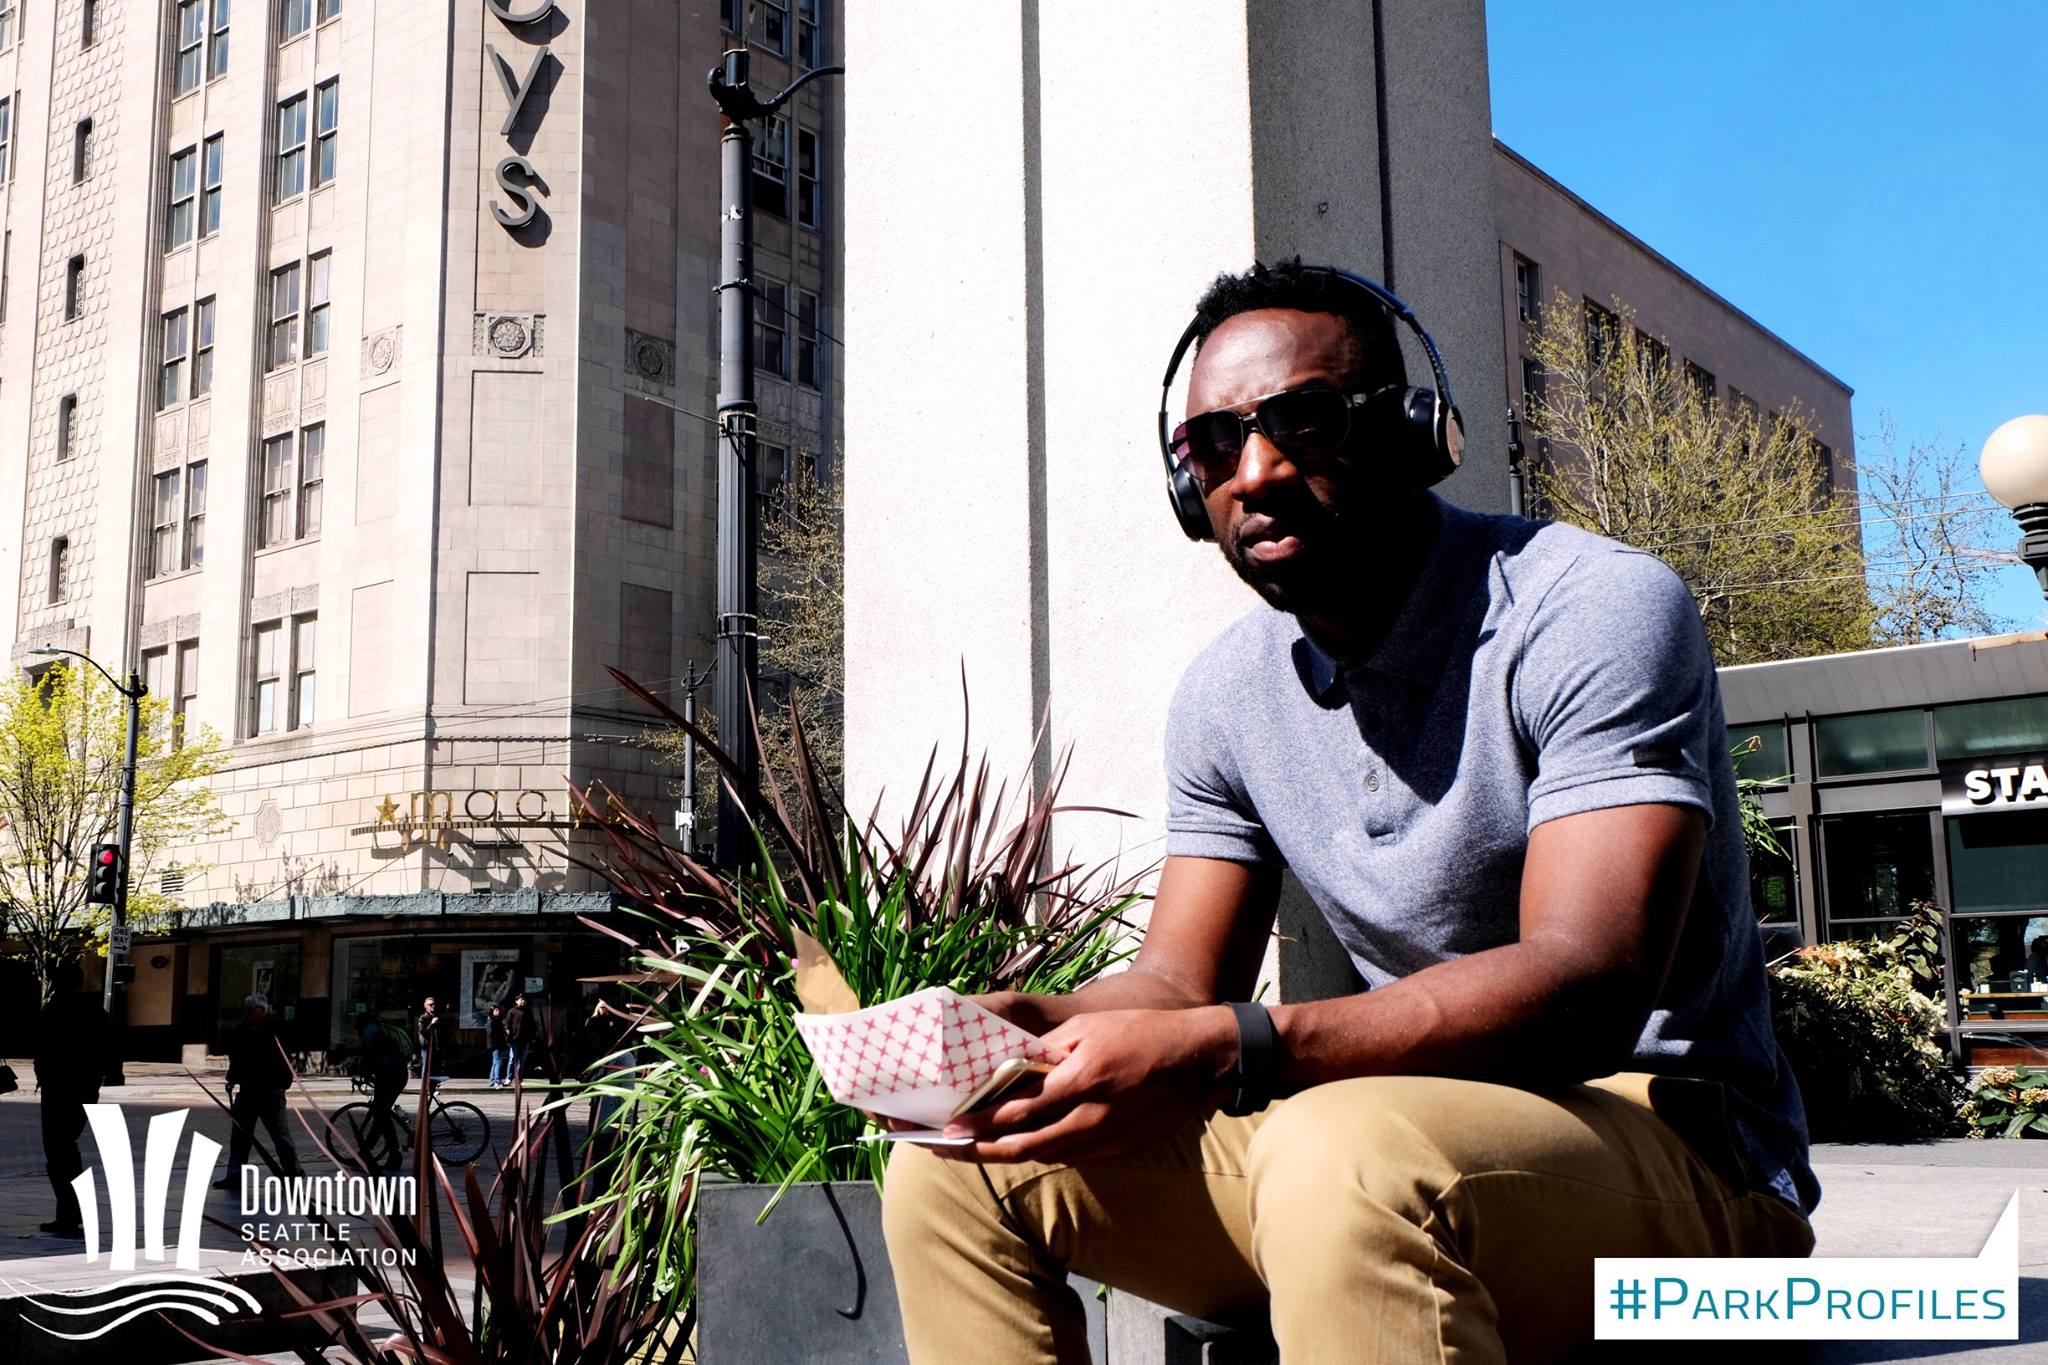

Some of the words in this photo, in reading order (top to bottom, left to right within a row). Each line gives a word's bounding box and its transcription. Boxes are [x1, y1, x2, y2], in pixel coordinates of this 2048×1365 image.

[1965, 764, 2048, 800] STA
[114, 928, 129, 936] ONE
[113, 936, 129, 944] WAY
